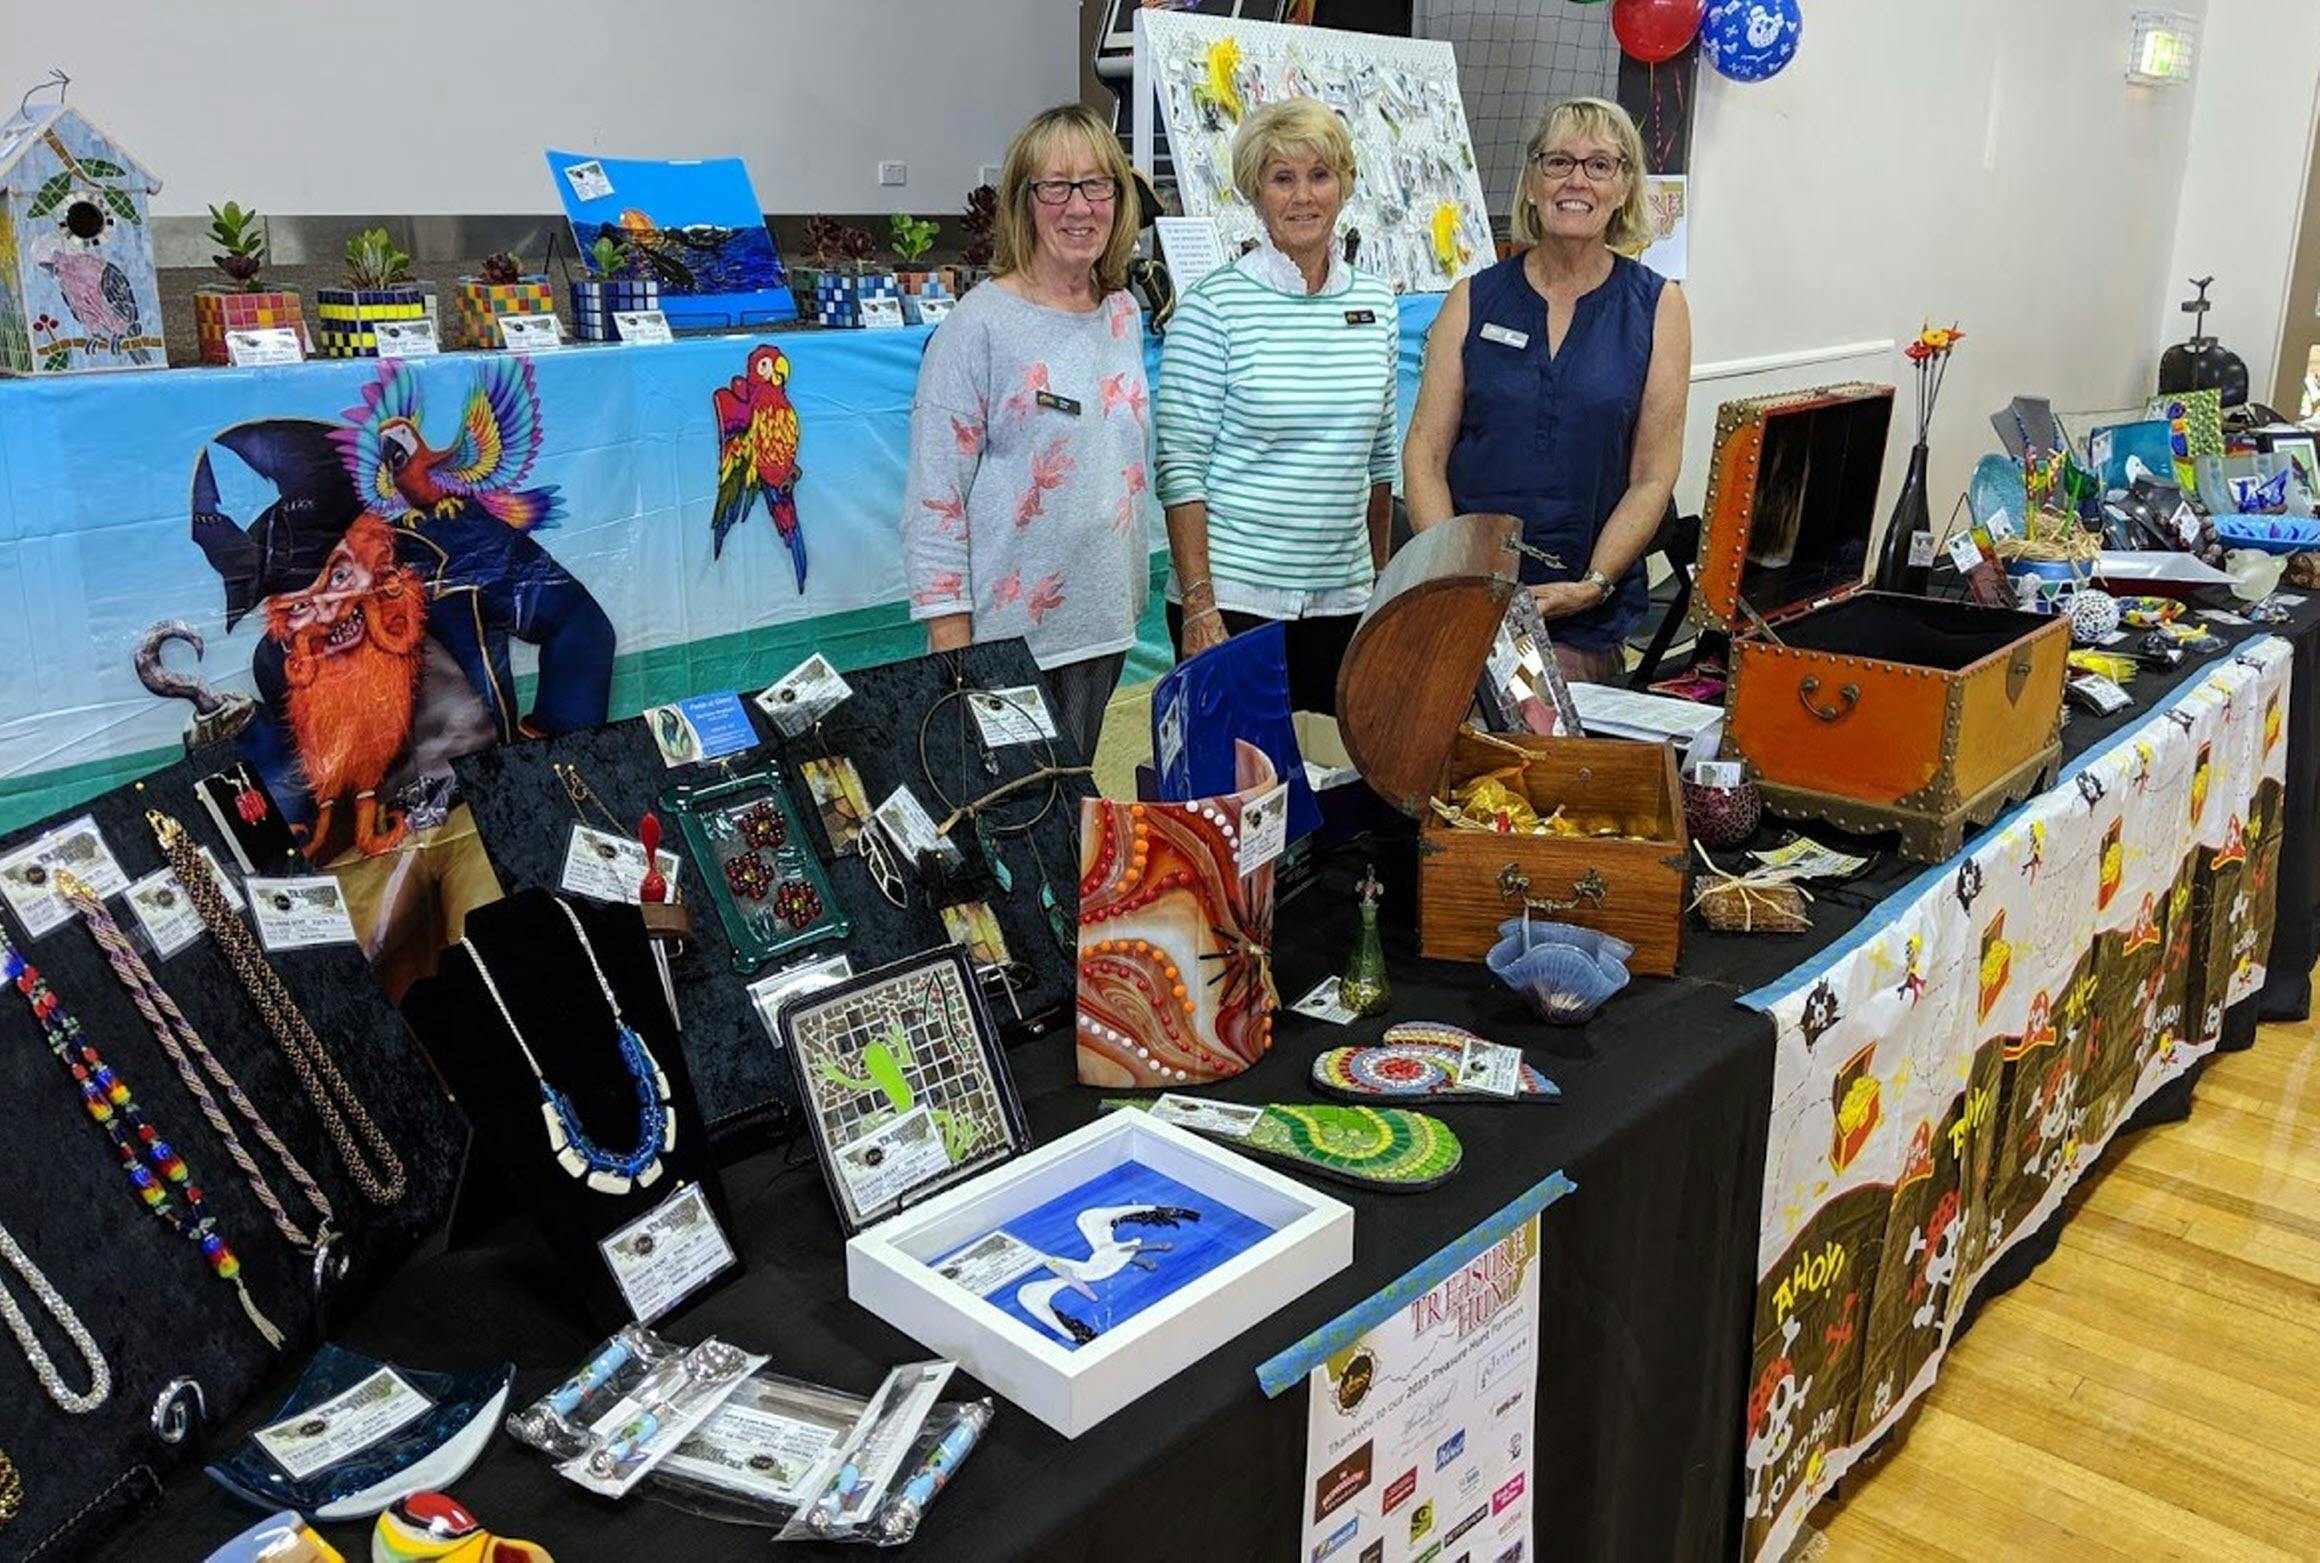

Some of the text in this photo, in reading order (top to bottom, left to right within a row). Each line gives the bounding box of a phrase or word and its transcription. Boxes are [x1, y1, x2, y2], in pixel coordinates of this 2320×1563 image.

[1456, 1271, 1519, 1338] HUNT
[1772, 1241, 1845, 1325] AHOY!
[1431, 1347, 1468, 1380] Treasure
[1469, 1329, 1490, 1352] Hunt
